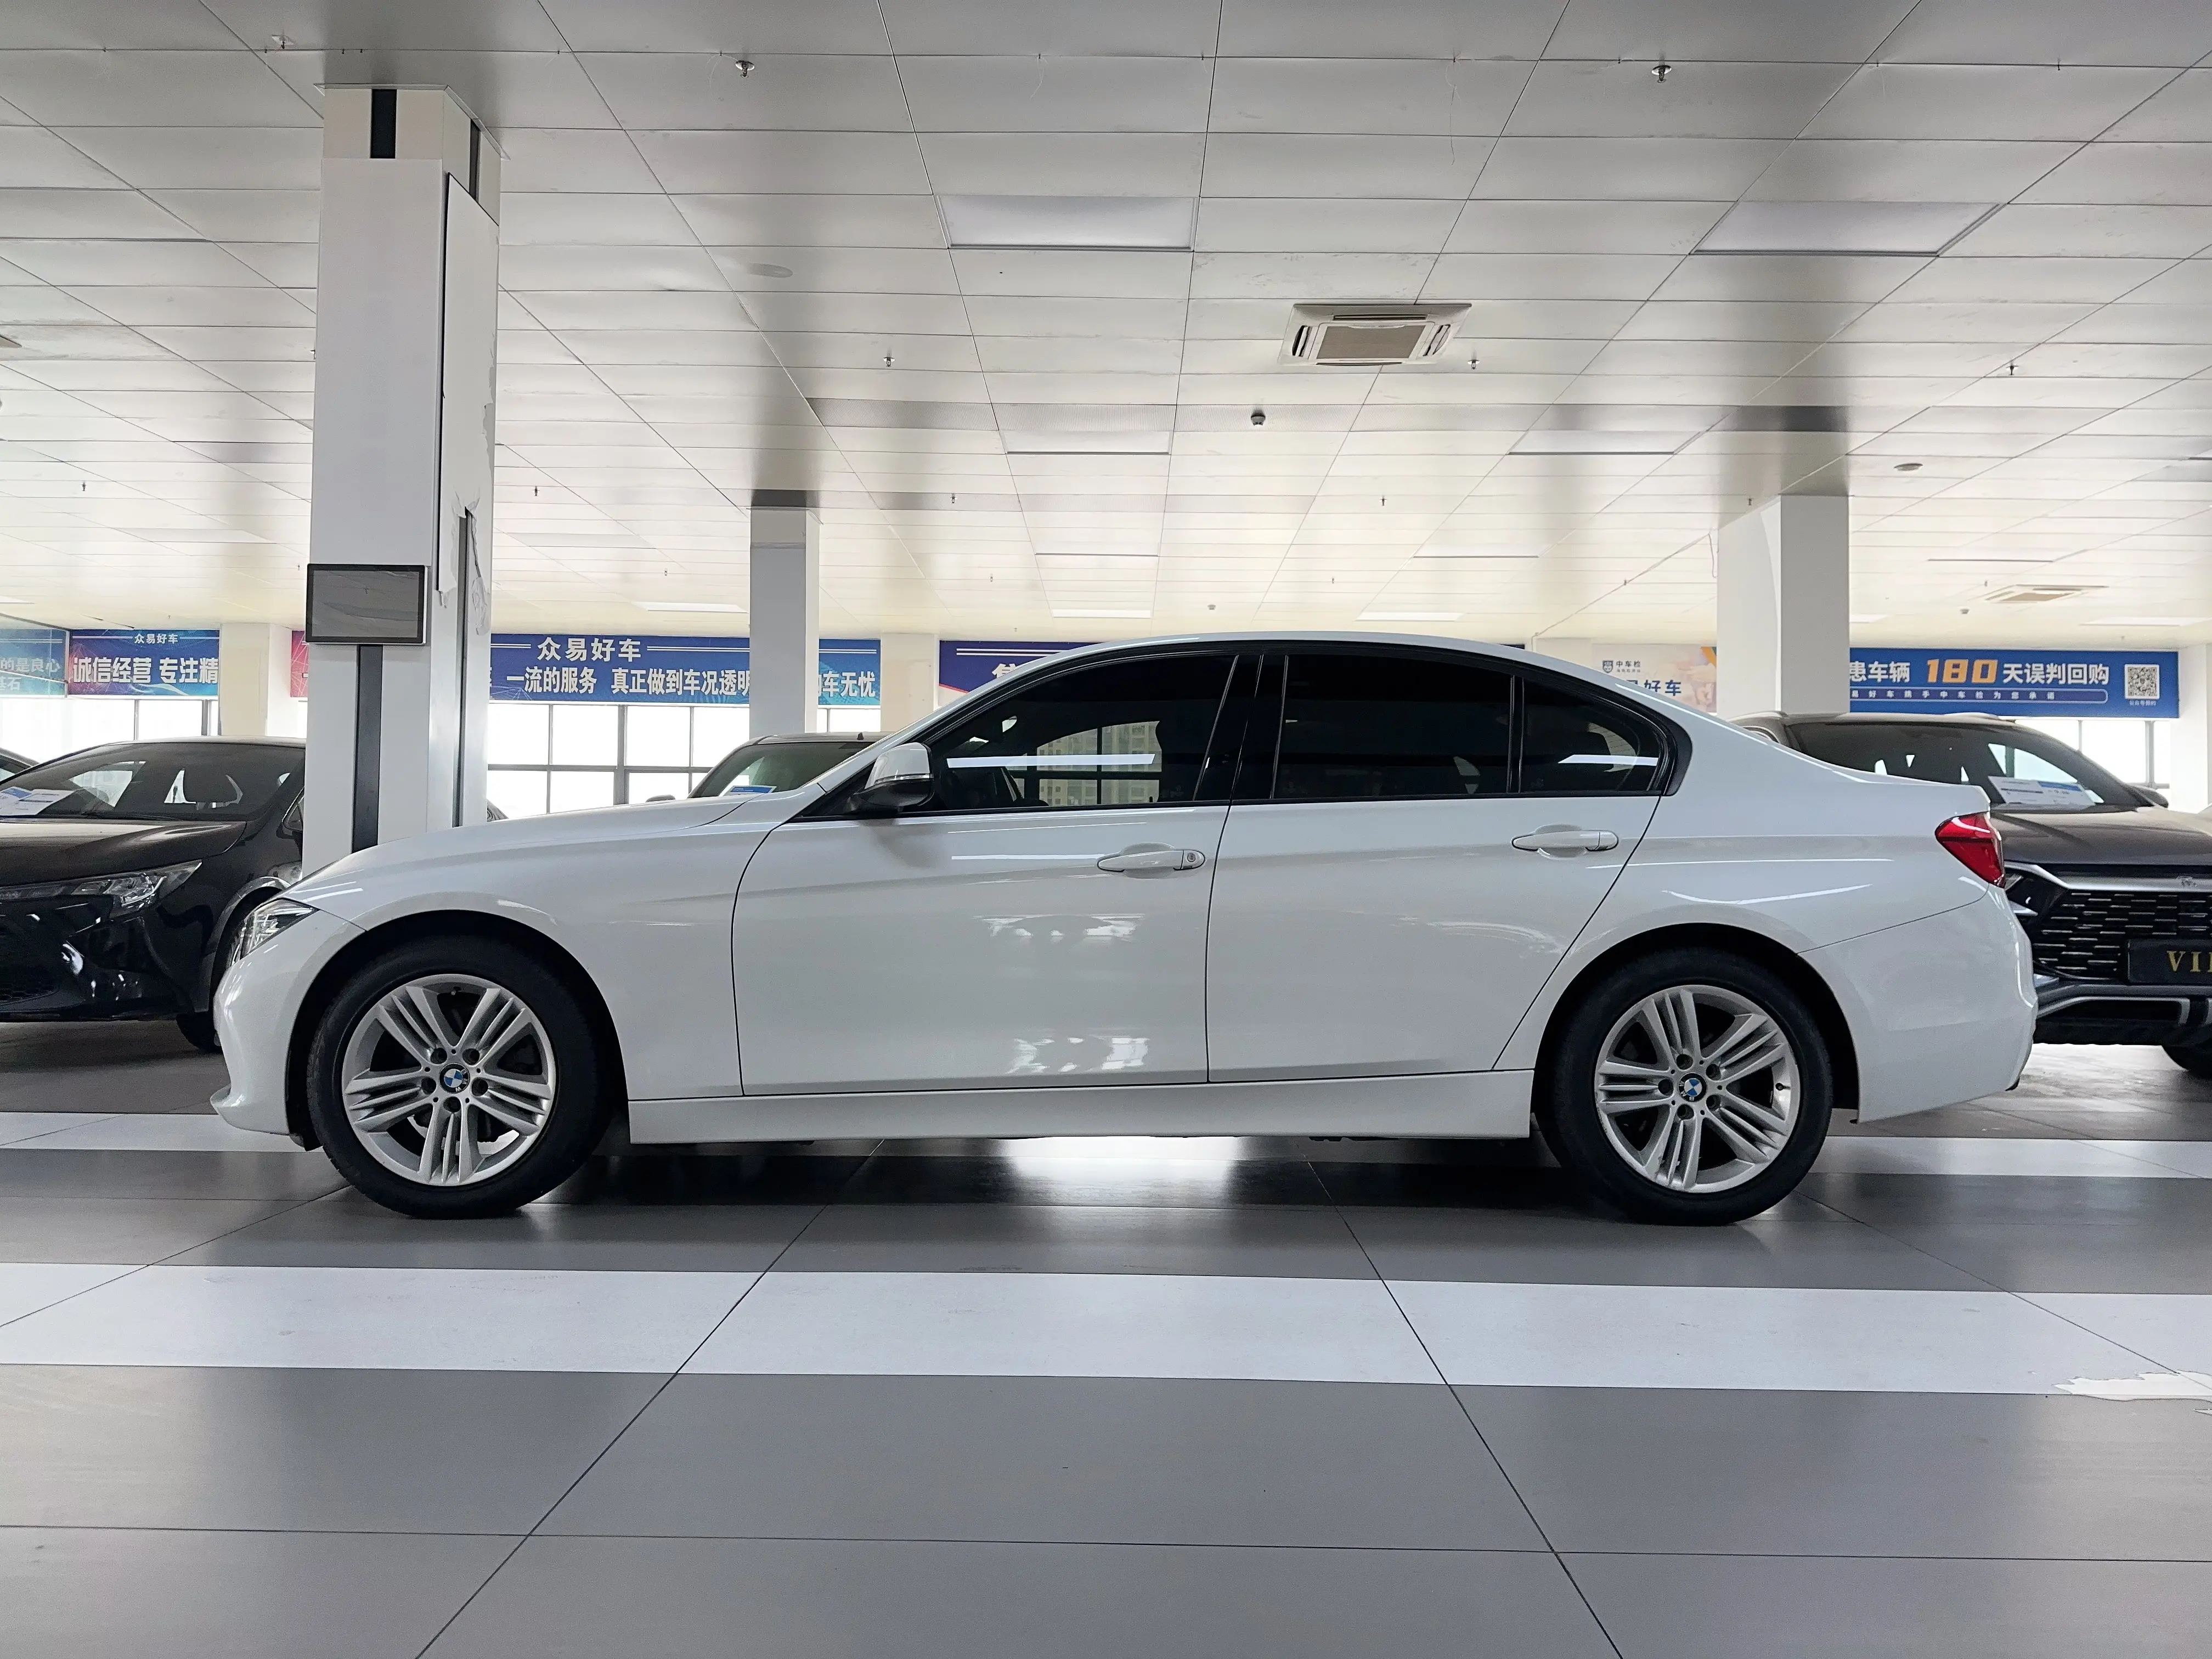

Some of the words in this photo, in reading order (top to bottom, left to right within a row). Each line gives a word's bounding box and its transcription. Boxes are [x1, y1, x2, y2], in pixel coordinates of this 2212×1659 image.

[134, 634, 178, 644] 众易好车
[537, 636, 641, 662] 众易好车
[1, 658, 61, 673] 的是良心
[73, 657, 152, 684] 诚信经营
[159, 657, 218, 684] 专注精
[1849, 661, 1910, 683] 患车辆
[1927, 659, 1998, 683] 180
[2003, 663, 2109, 685] 天误判回购
[506, 666, 597, 694] 一流的服务
[611, 667, 750, 696] 真正做到车况透明
[818, 670, 876, 697] 车无忧
[1626, 679, 1681, 696] 好车
